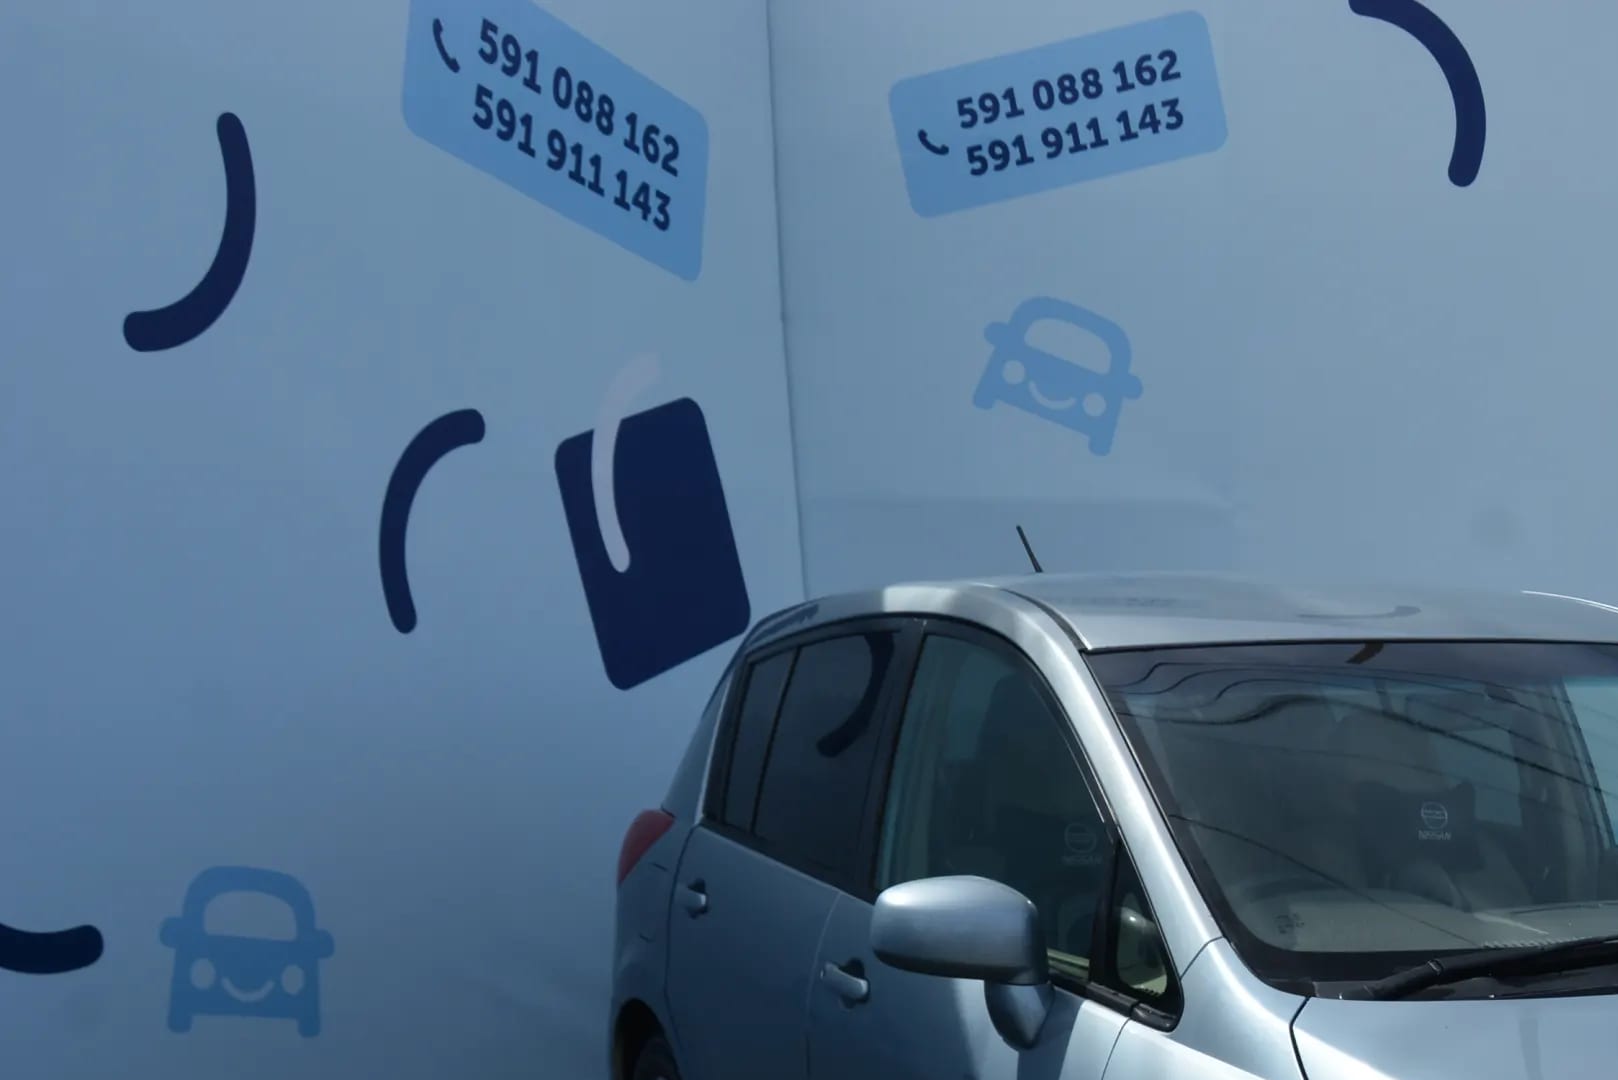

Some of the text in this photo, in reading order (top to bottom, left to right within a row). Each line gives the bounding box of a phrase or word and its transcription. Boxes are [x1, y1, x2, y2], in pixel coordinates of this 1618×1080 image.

[477, 17, 681, 178] 591 088 162
[956, 49, 1182, 130] 591 088 162
[966, 97, 1184, 177] 591 911 143
[472, 83, 671, 232] 591 911 143
